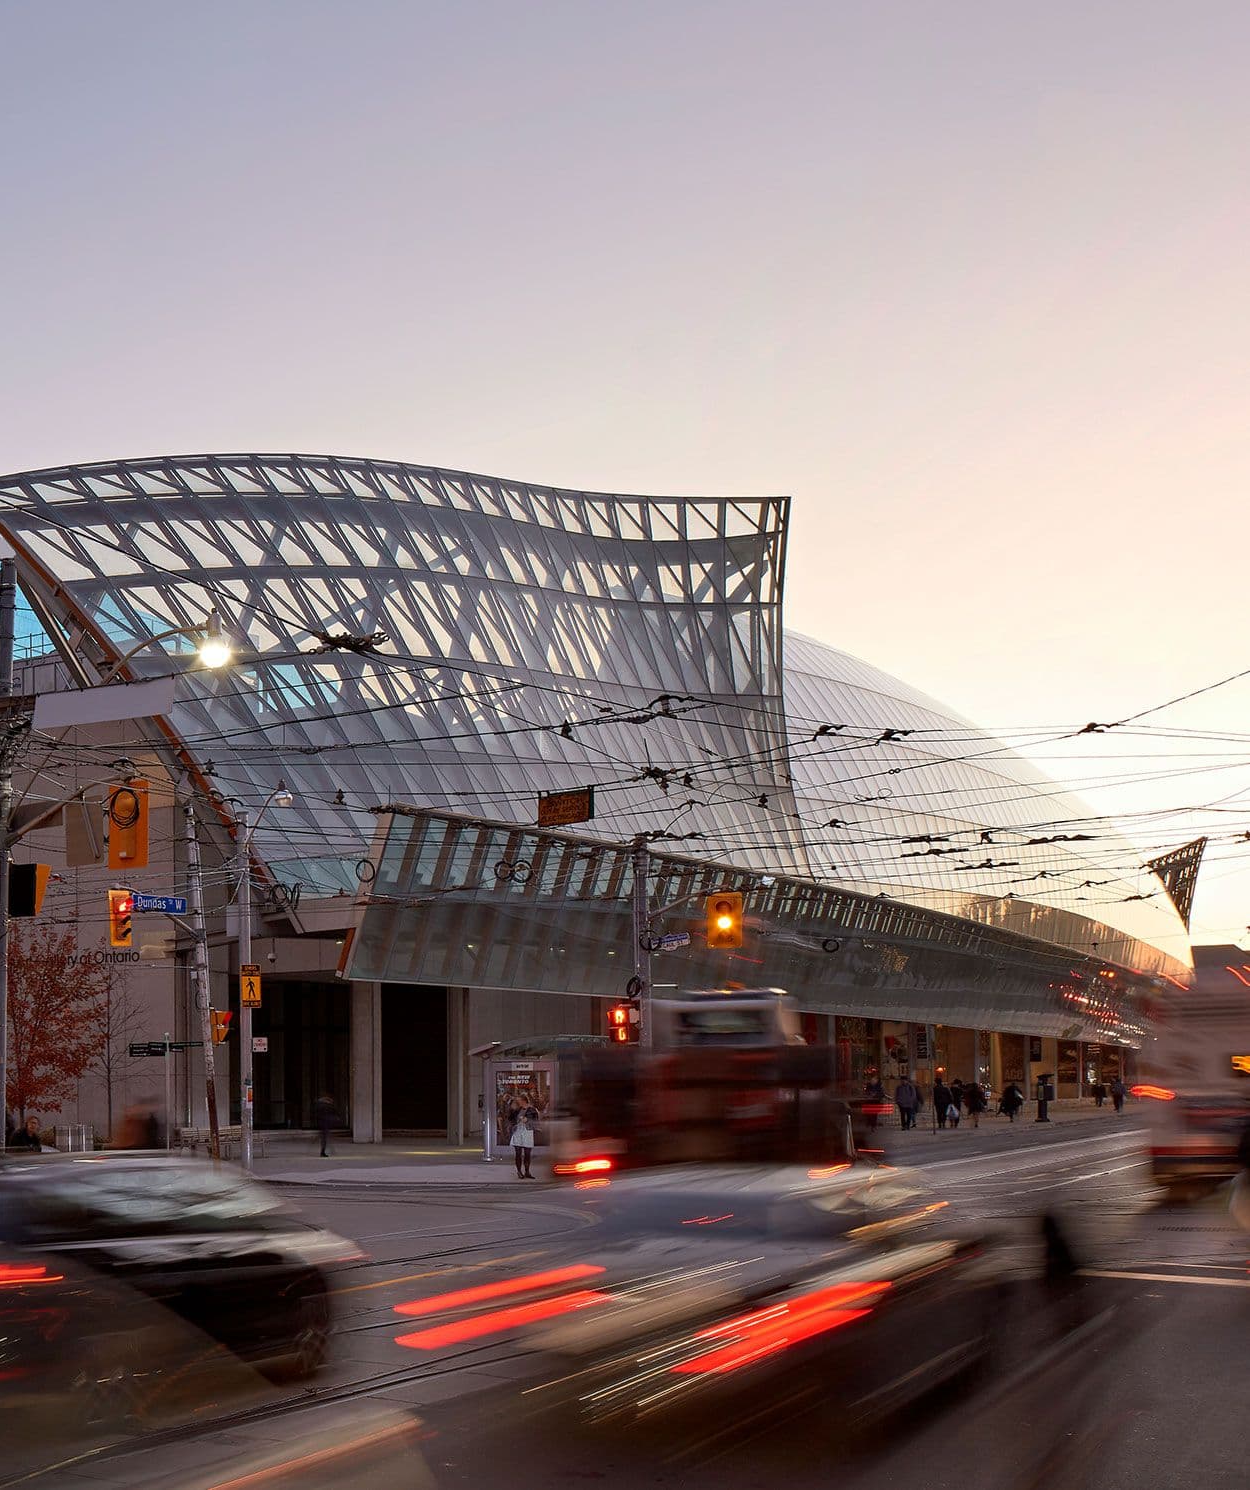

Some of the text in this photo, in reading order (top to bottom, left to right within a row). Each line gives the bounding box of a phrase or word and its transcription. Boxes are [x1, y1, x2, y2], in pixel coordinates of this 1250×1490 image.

[137, 896, 167, 910] Dundas
[175, 899, 183, 910] W
[94, 949, 140, 964] Ontario
